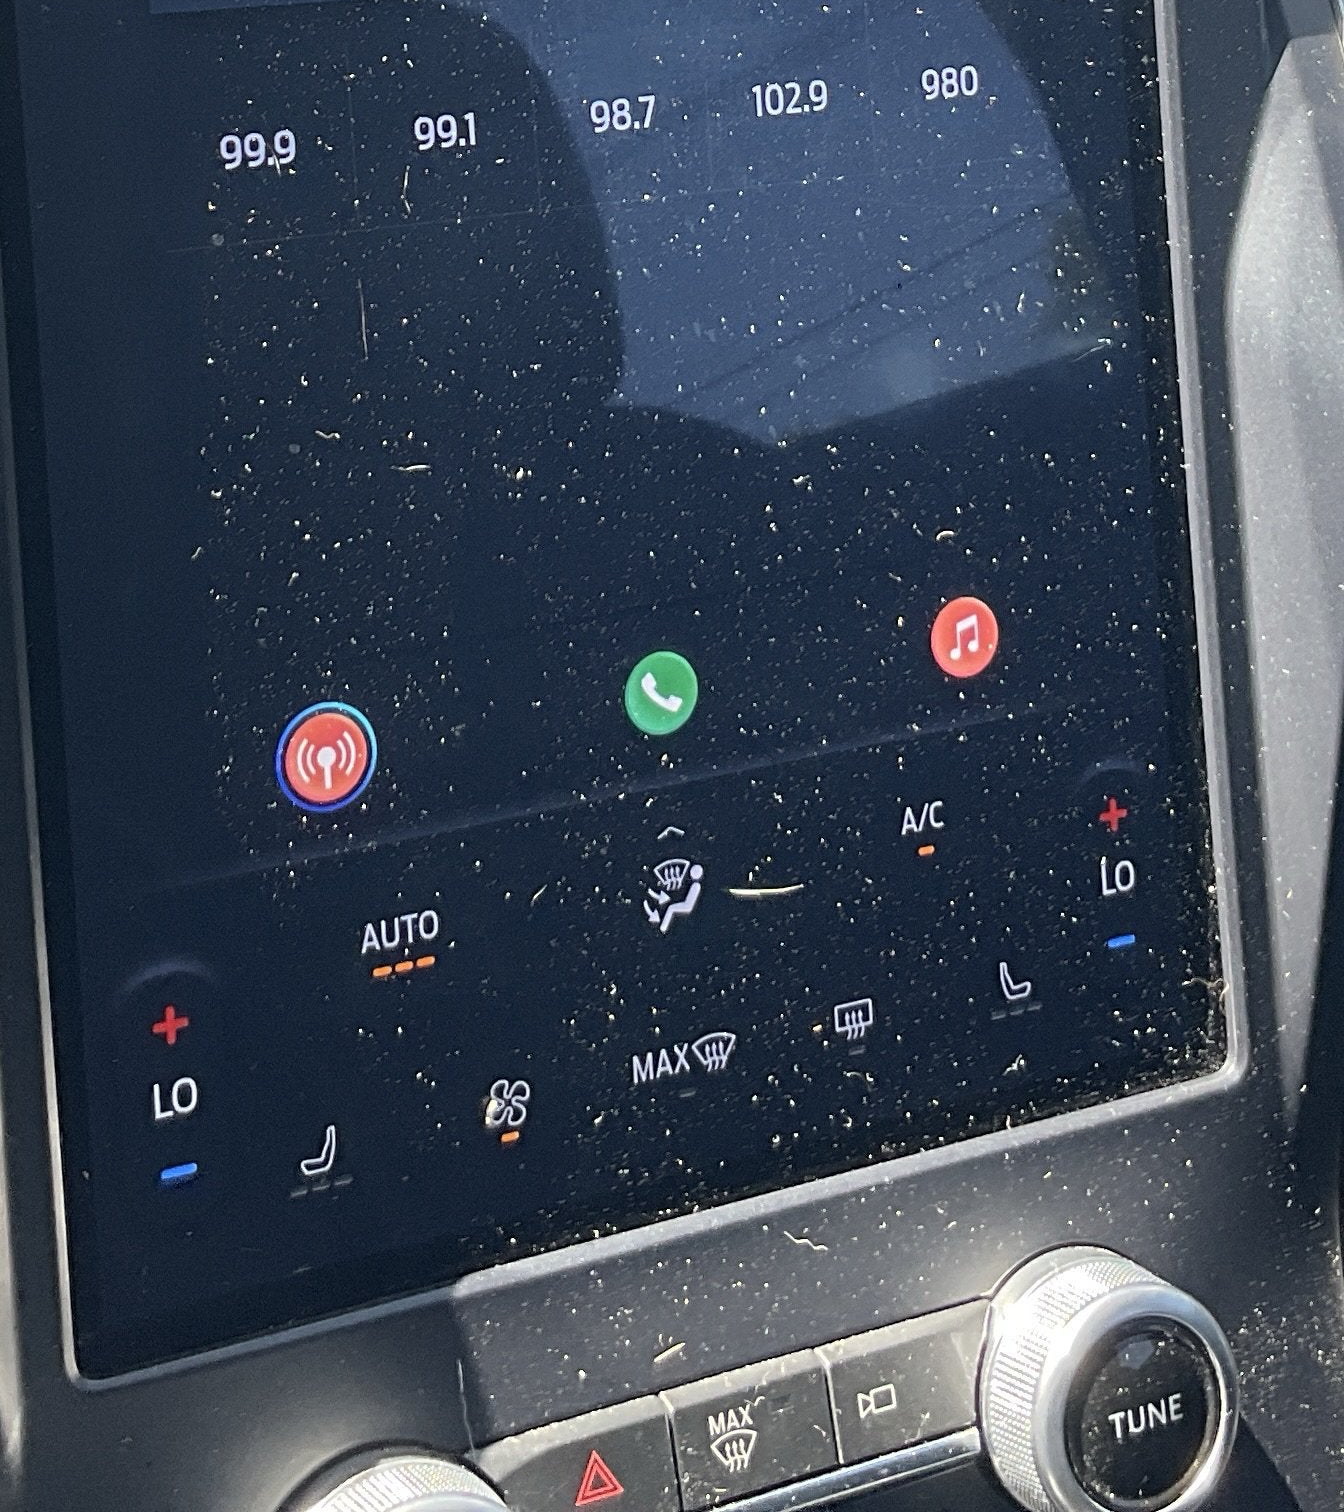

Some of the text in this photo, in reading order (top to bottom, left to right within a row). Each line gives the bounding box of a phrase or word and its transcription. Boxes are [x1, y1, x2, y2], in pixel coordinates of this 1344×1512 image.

[752, 80, 829, 117] 102.9
[921, 65, 979, 100] 980
[413, 112, 478, 151] 99.1
[589, 94, 657, 134] 98.7
[219, 129, 297, 171] 99.9
[901, 800, 945, 836] A/C
[1100, 858, 1135, 897] LO
[361, 909, 440, 954] AUTO
[632, 1042, 691, 1086] MAX
[153, 1076, 198, 1120] LO
[707, 1405, 755, 1437] MAX
[1108, 1392, 1184, 1441] TUNE
